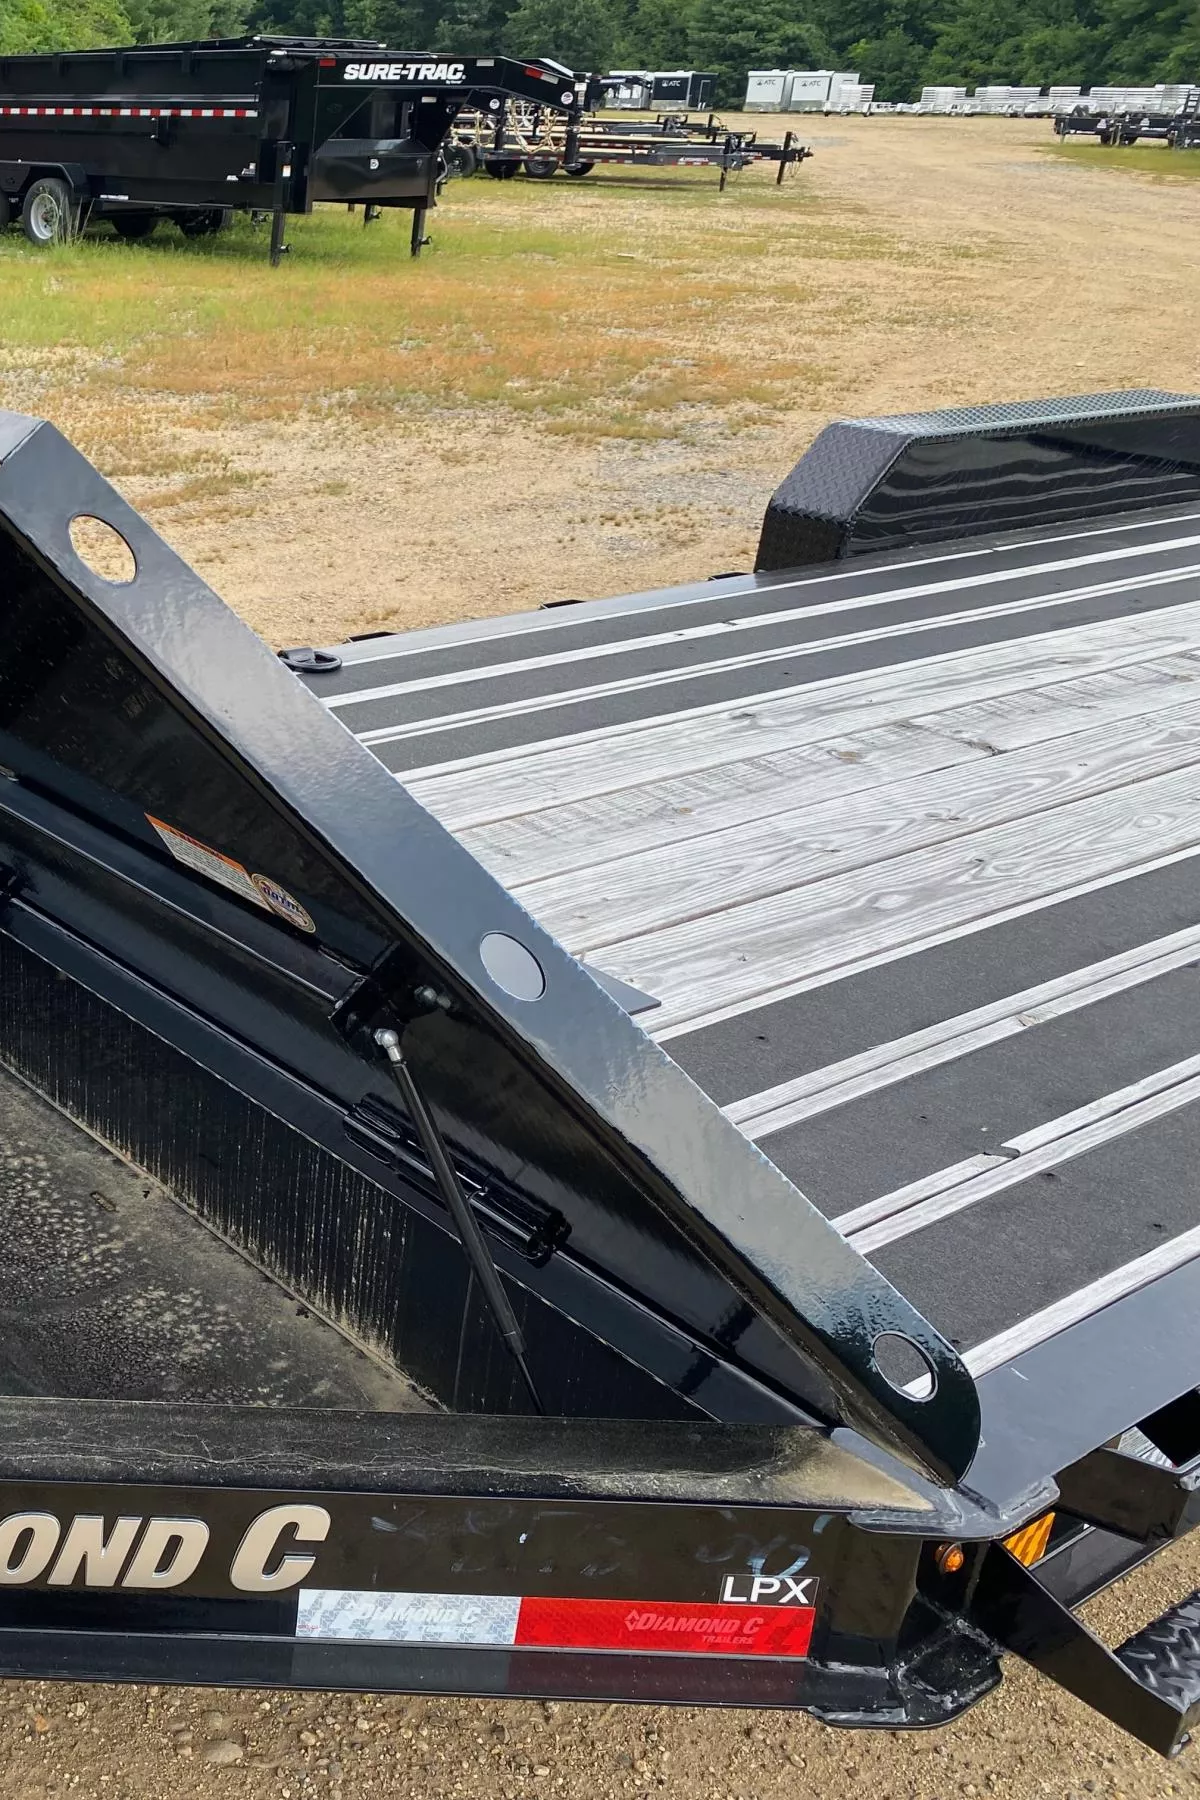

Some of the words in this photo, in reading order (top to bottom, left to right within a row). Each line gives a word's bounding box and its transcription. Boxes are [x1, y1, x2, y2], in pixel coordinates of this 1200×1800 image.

[229, 1504, 332, 1592] C
[722, 1576, 813, 1604] LPX
[461, 1606, 482, 1624] C
[636, 1612, 741, 1634] DIAMOND
[742, 1616, 764, 1635] C
[702, 1635, 755, 1645] TRAILERS
